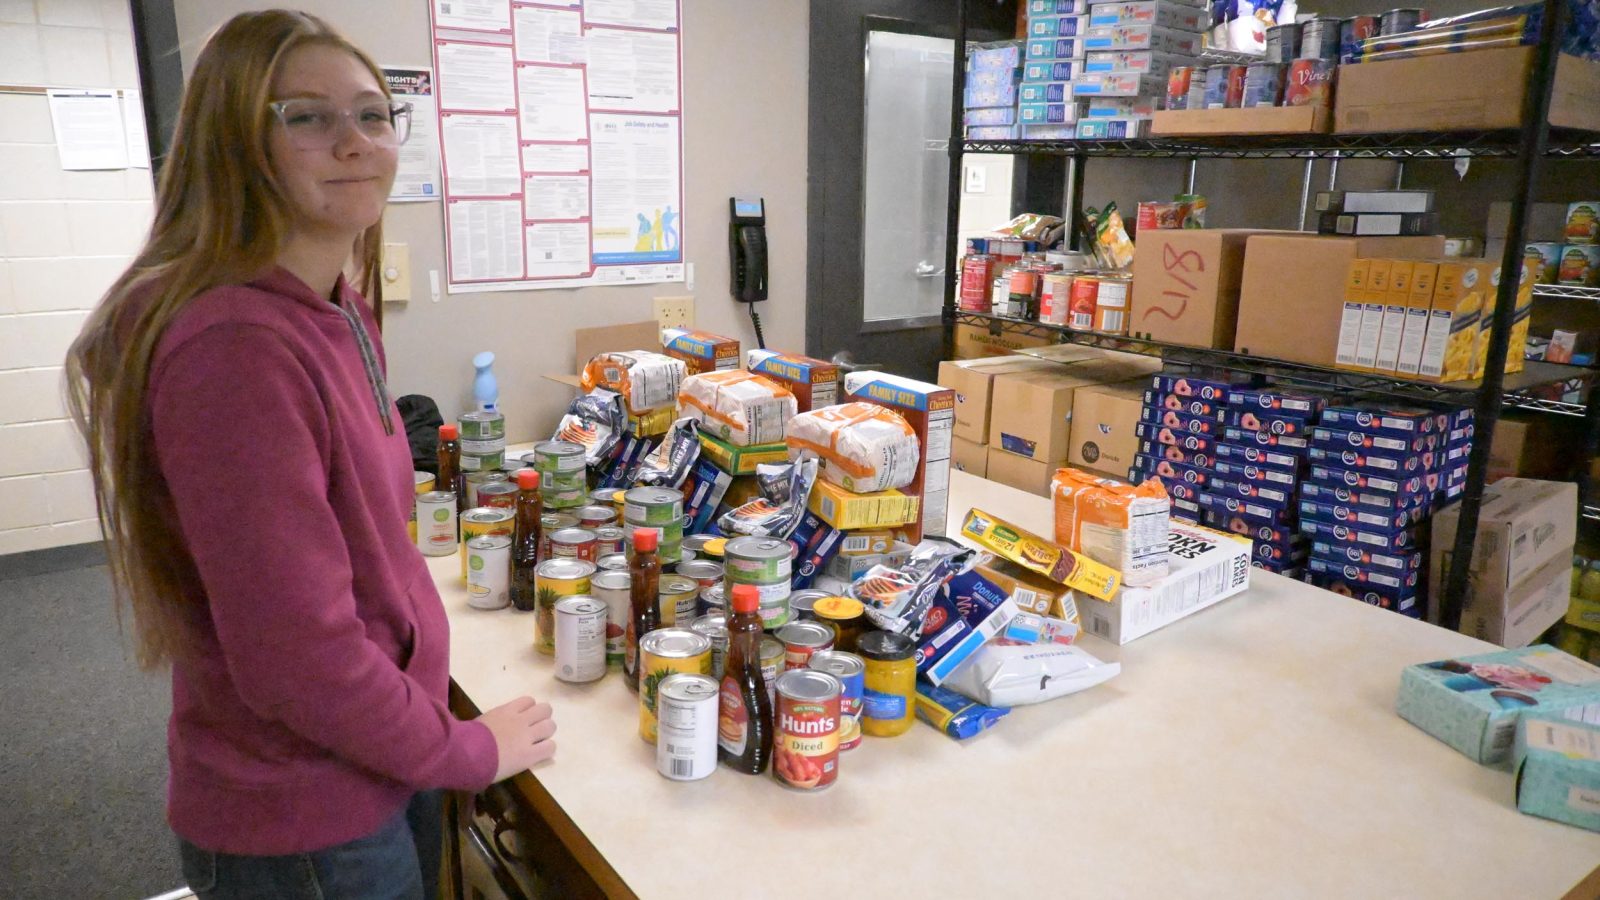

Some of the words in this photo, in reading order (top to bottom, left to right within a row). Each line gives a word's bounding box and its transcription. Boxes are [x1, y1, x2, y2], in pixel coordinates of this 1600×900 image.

[676, 338, 693, 352] FAMILY
[694, 344, 704, 355] SIZE
[765, 360, 786, 376] FAMILY
[787, 366, 800, 380] SIZE
[868, 384, 896, 402] FAMILY
[899, 392, 916, 406] SIZE
[930, 399, 954, 410] Cheerios
[1168, 534, 1216, 554] ORN
[1168, 544, 1201, 559] KES
[972, 582, 1002, 606] Donuts
[792, 740, 823, 752] Diced
